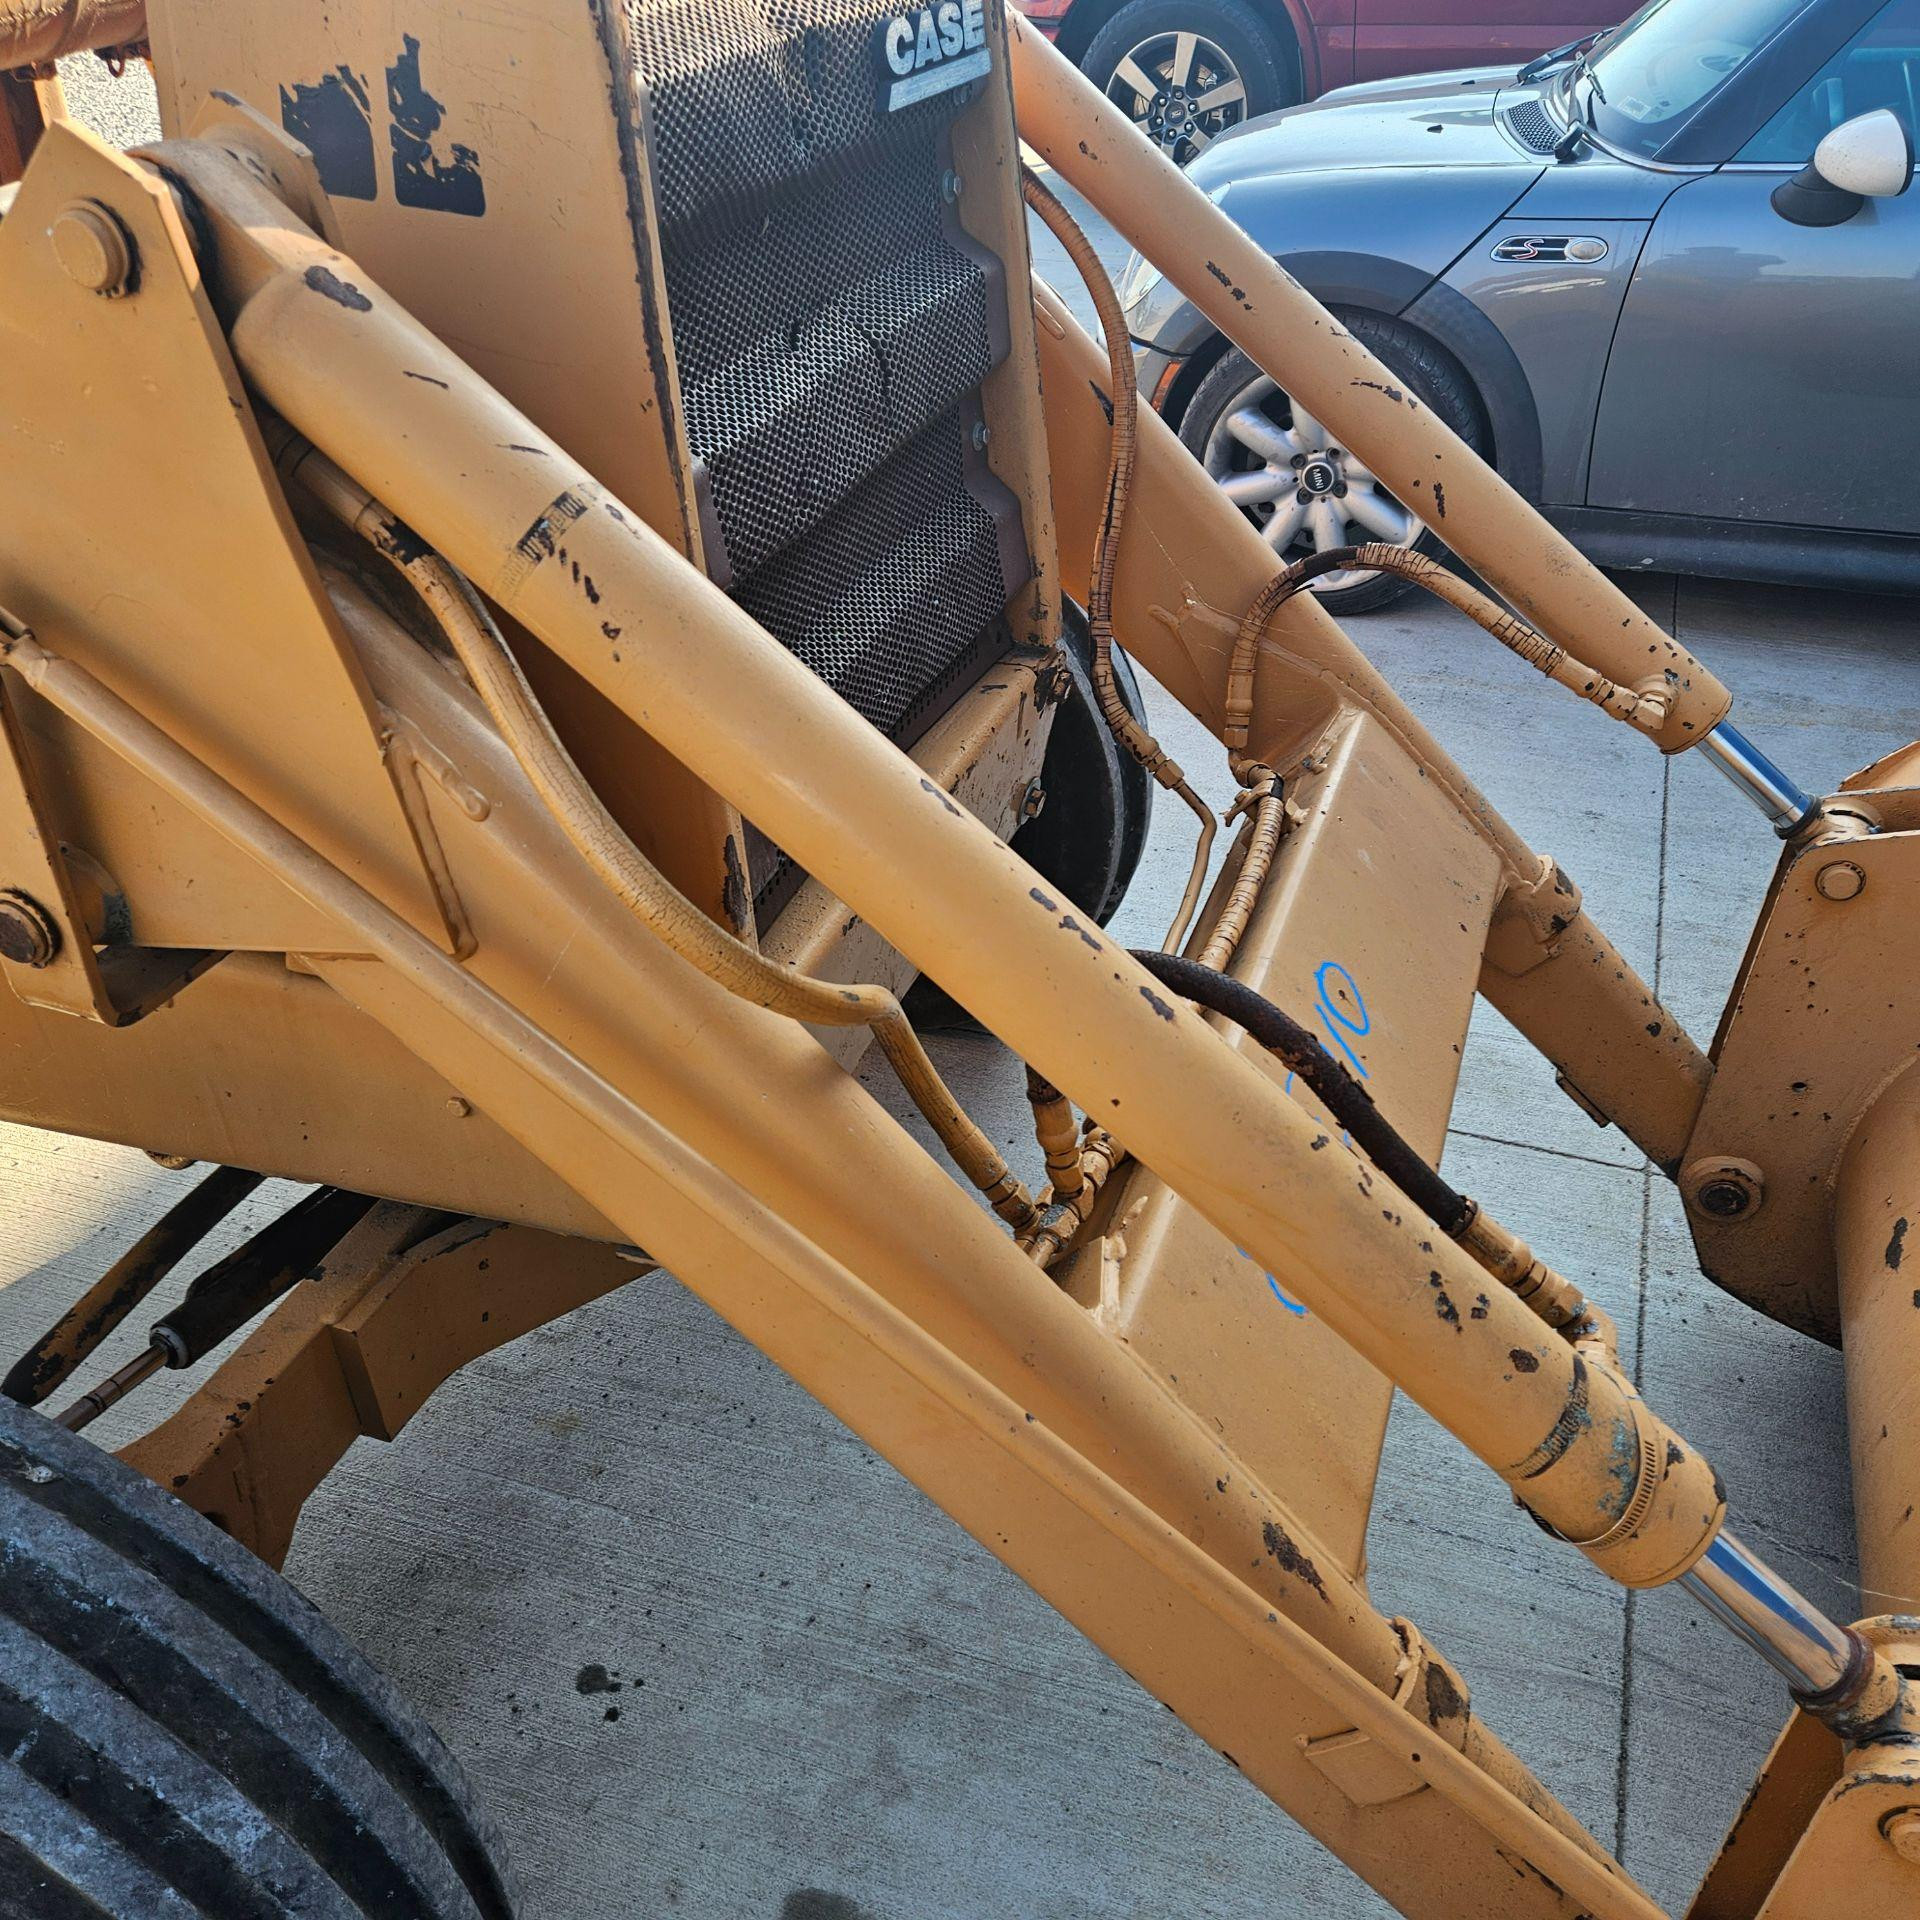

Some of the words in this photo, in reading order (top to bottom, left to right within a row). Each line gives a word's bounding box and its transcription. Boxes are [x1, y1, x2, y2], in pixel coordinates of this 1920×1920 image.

[886, 0, 985, 75] CASE
[1511, 239, 1544, 260] S
[1312, 468, 1325, 489] MINI
